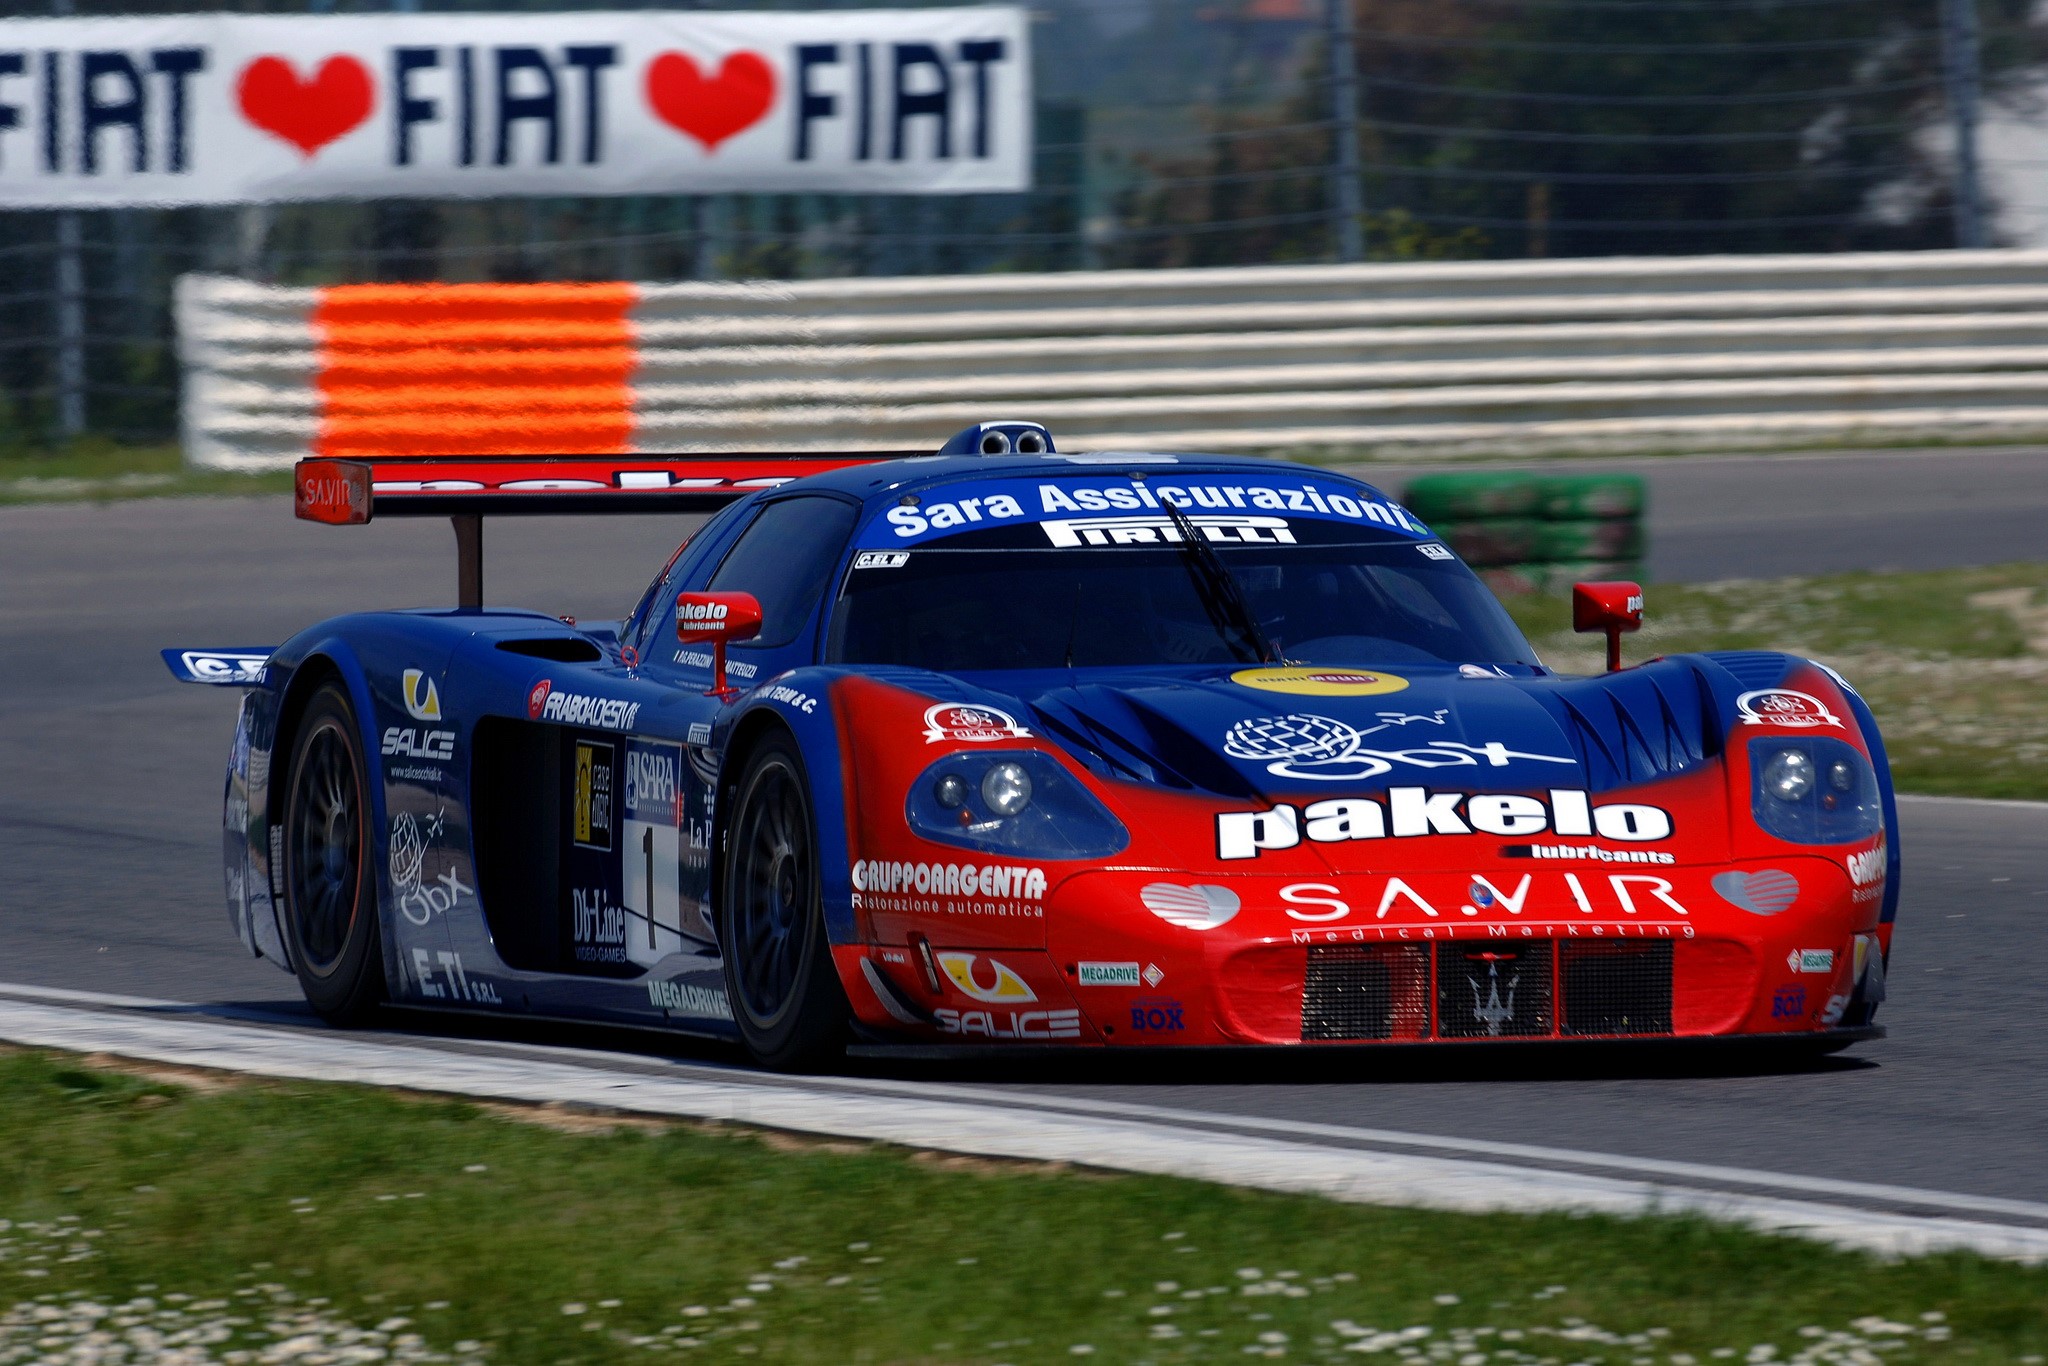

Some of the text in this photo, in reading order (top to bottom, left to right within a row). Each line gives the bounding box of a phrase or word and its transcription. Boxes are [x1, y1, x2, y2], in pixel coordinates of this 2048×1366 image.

[391, 43, 618, 166] FIAT
[792, 38, 1010, 162] FIAT
[886, 481, 1414, 538] Sara Assicurazioni
[381, 726, 456, 761] SALICE
[639, 751, 677, 803] SARA
[1216, 786, 1676, 861] pakelo
[1530, 843, 1676, 865] lubricants
[642, 826, 657, 951] 1
[851, 893, 1044, 918] Ristorazione automatica
[1292, 922, 1696, 944] Medical Marketing
[1080, 966, 1139, 982] MEGADRIVE
[647, 980, 733, 1020] MEGADRIVE
[1130, 1006, 1186, 1031] BOX
[933, 1008, 1081, 1039] SALICE
